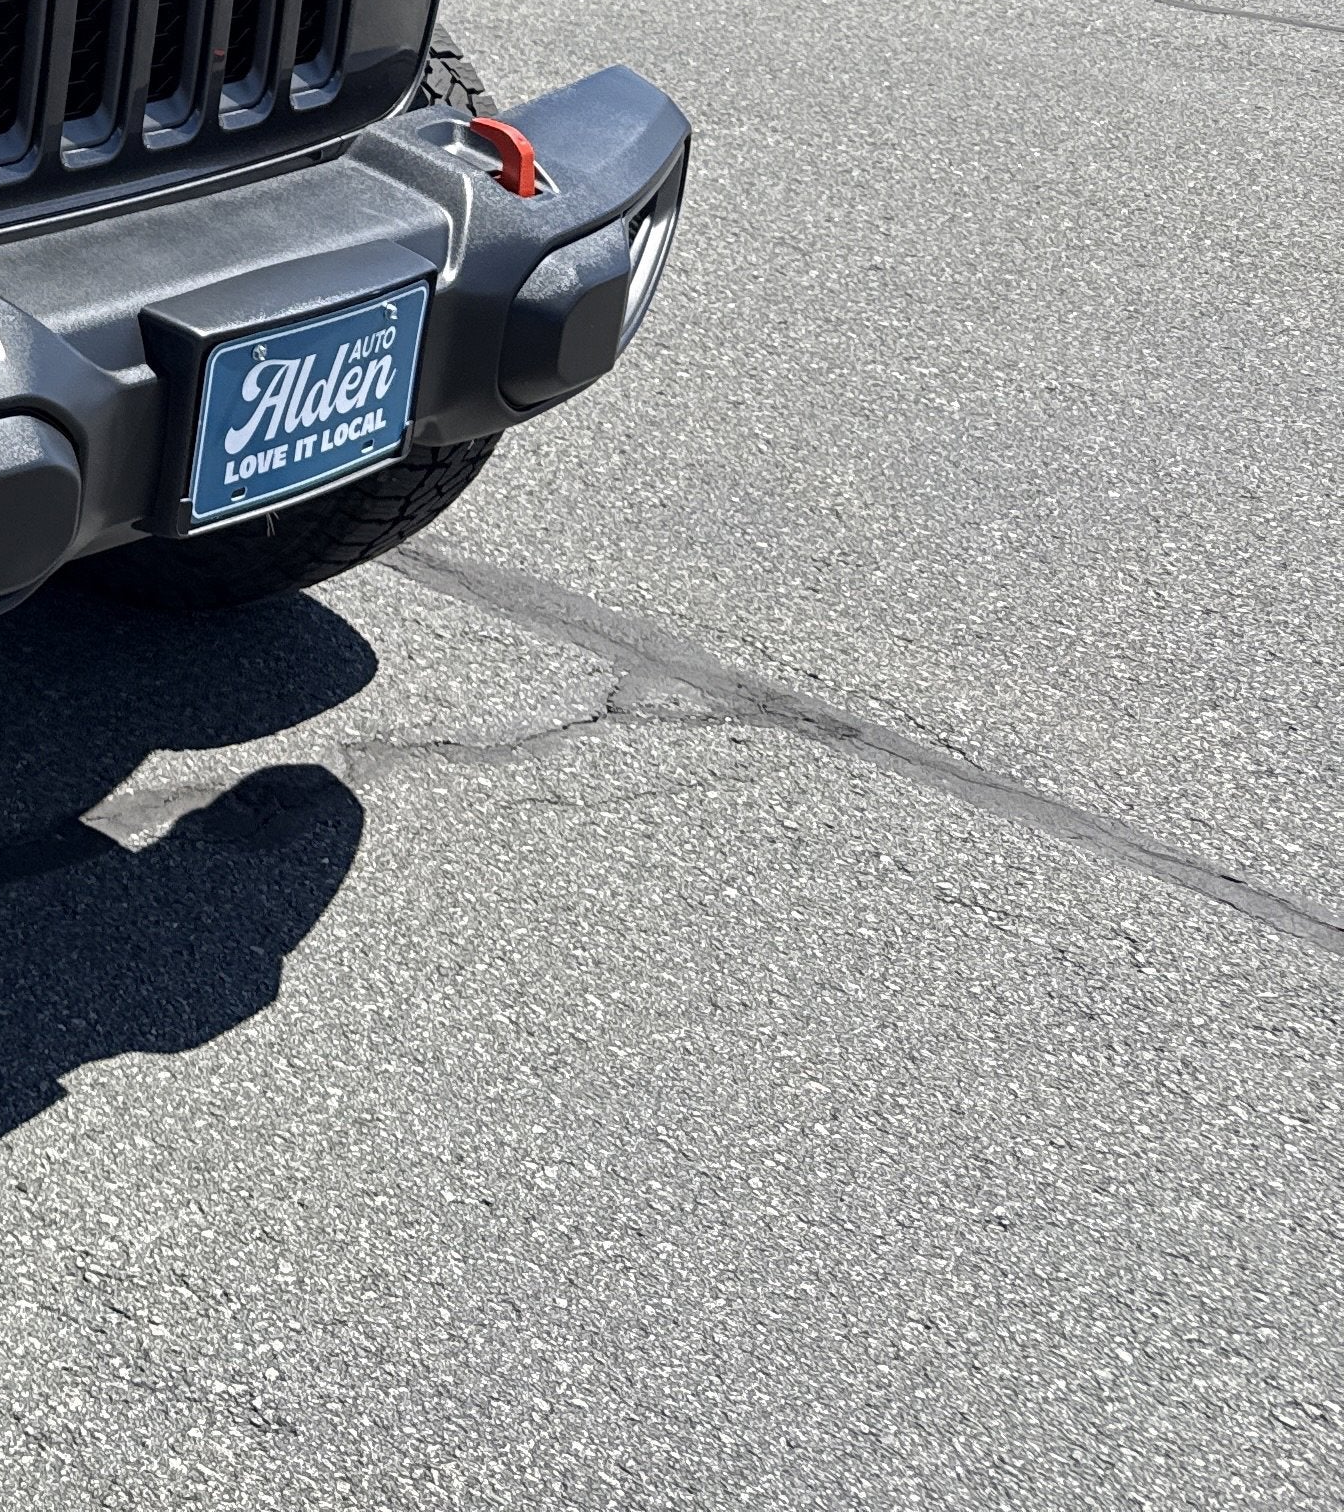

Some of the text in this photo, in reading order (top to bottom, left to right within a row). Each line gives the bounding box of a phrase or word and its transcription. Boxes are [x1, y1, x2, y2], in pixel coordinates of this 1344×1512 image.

[349, 325, 396, 363] AUTO
[224, 342, 397, 455] Alden
[224, 408, 387, 485] LOVE IT LOCAL
